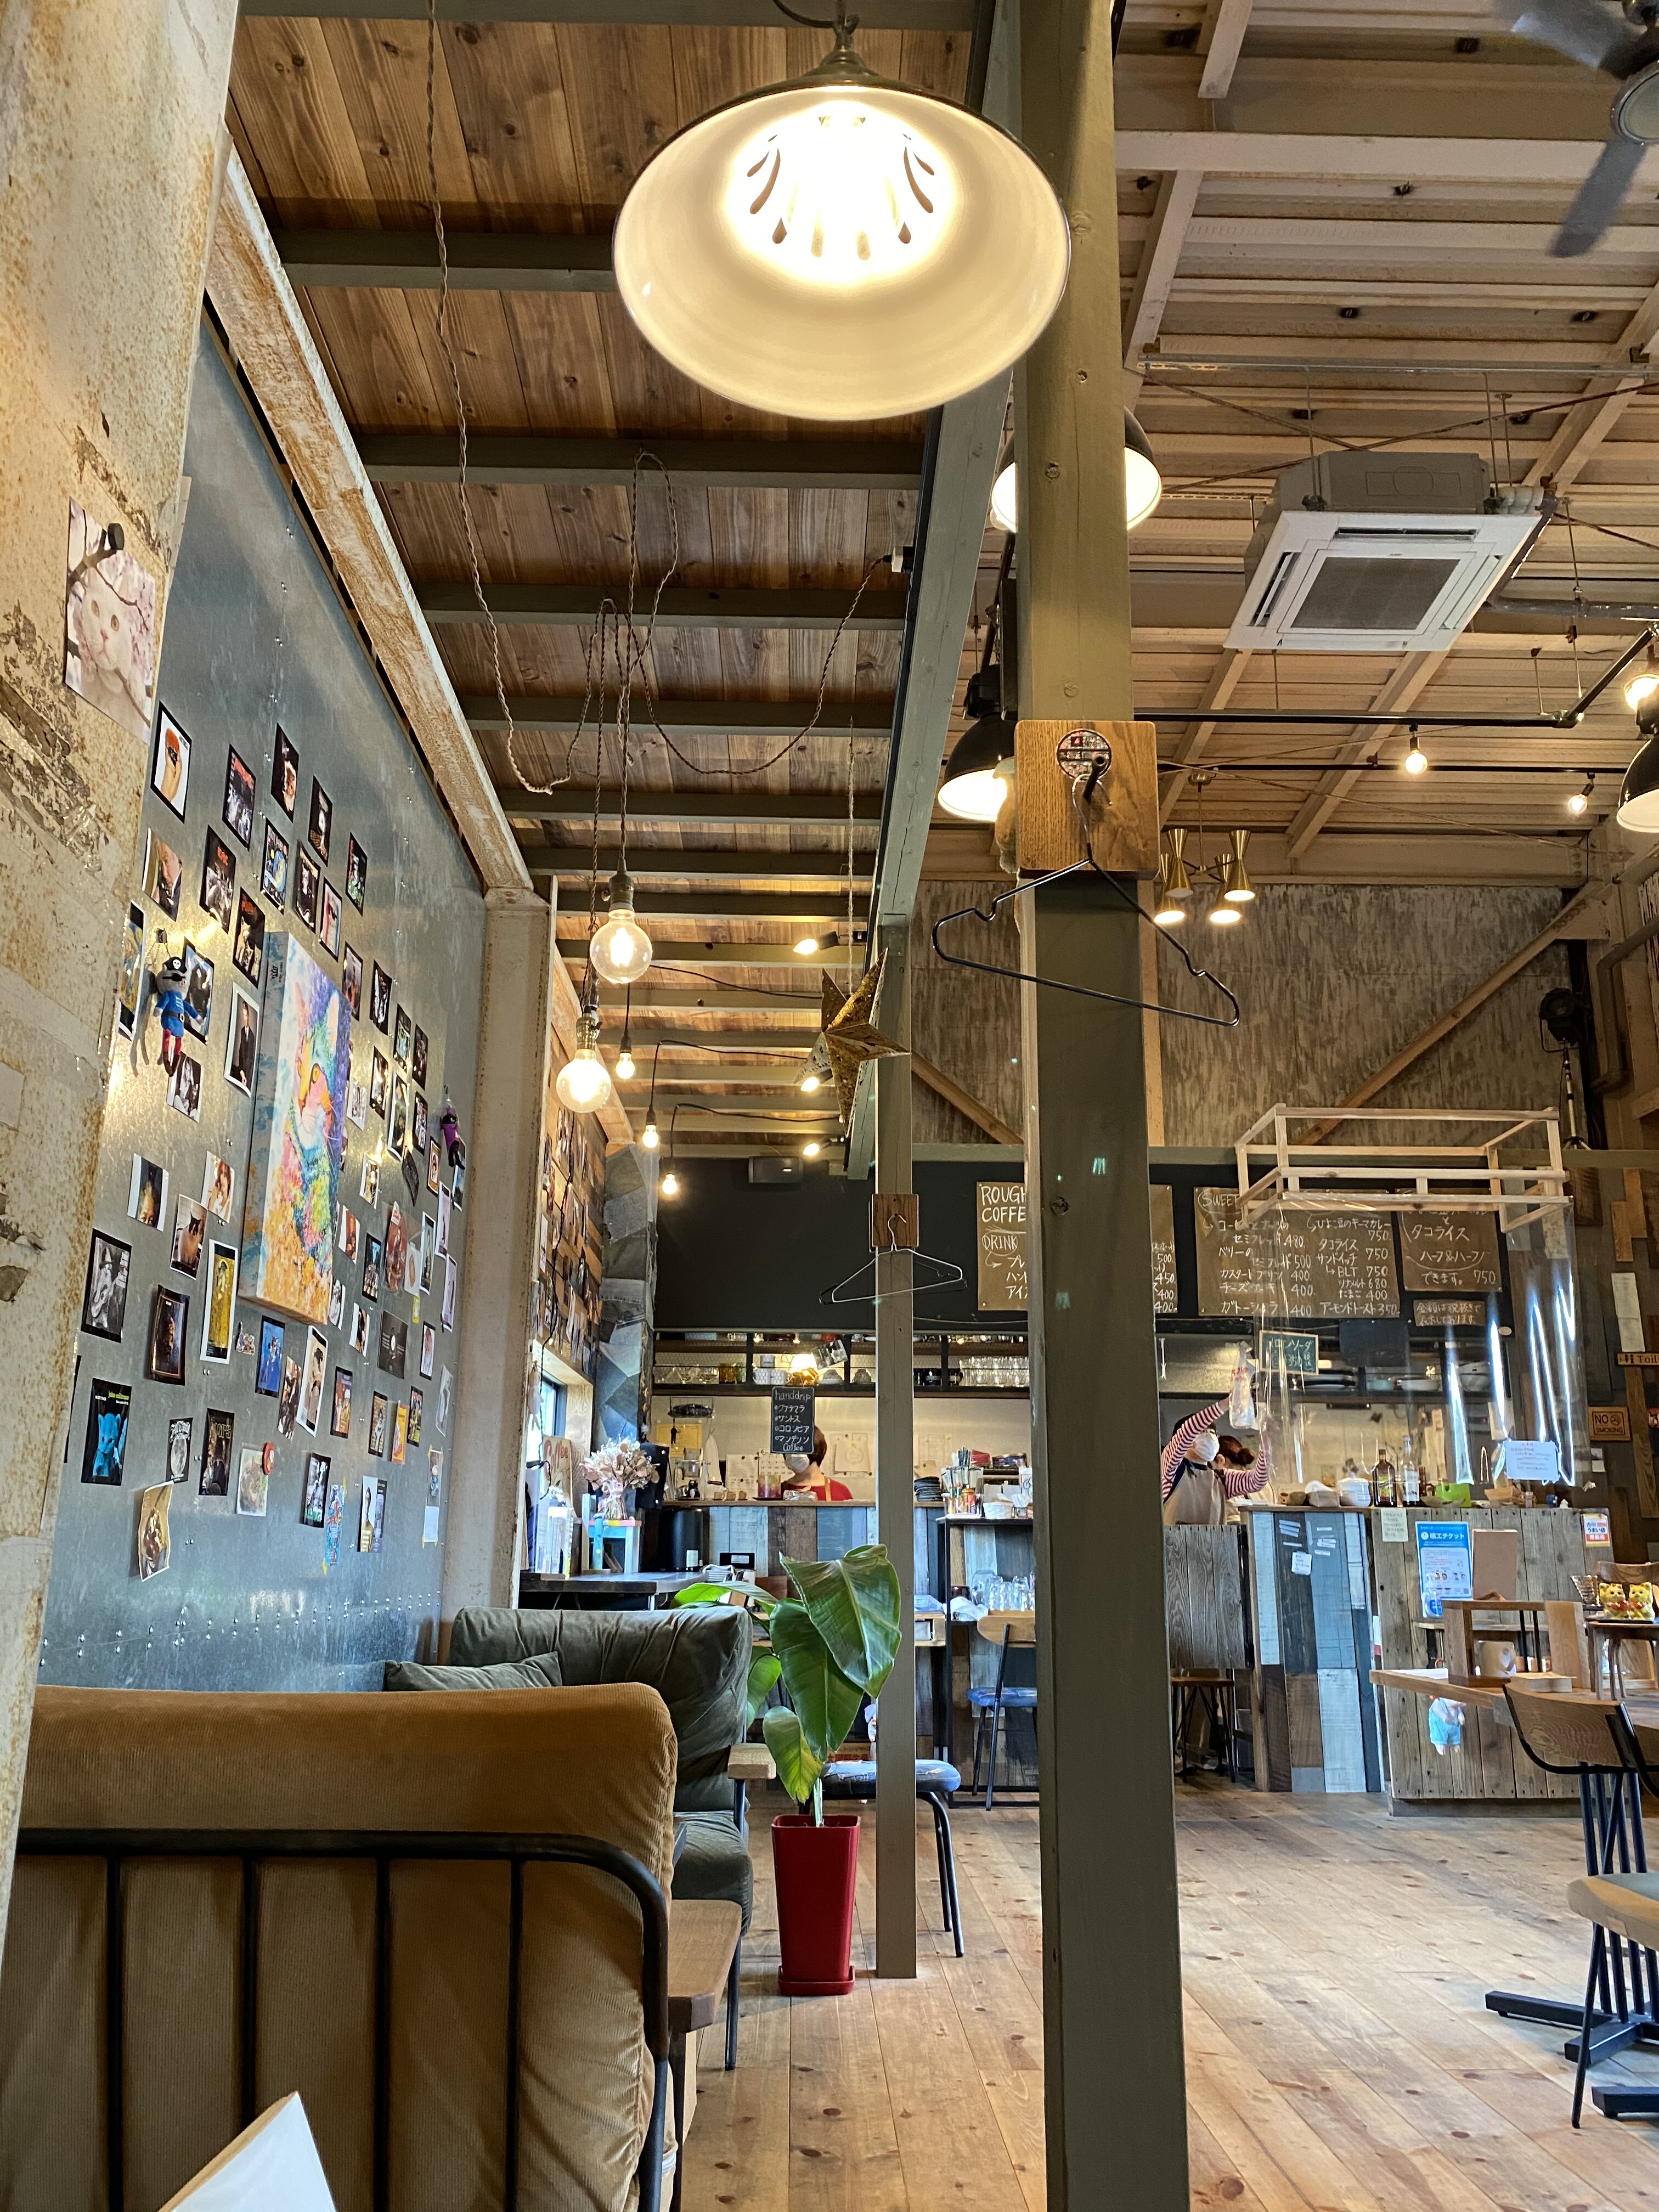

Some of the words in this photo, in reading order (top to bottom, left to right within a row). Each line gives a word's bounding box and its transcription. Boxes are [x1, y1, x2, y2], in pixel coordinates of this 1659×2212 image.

[981, 1186, 1026, 1206] ROUGH
[1316, 1217, 1391, 1229] ひよこ豆のキーマカレー
[1412, 1224, 1470, 1241] タコライス
[984, 1234, 1017, 1250] DRINK
[1318, 1238, 1359, 1251] タコライス
[1365, 1248, 1389, 1260] 750
[1157, 1253, 1172, 1263] 500
[1294, 1254, 1311, 1269] 500
[1316, 1251, 1358, 1266] サンドイッチ
[1338, 1266, 1359, 1278] BLT
[1366, 1265, 1389, 1278] 750
[1474, 1269, 1497, 1285] 750
[1338, 1278, 1365, 1289] ツナメルト
[1365, 1289, 1388, 1301] 400
[1319, 1301, 1376, 1316] アーモンドトースト
[775, 1389, 811, 1403] handdrip
[1594, 1414, 1609, 1424] NO
